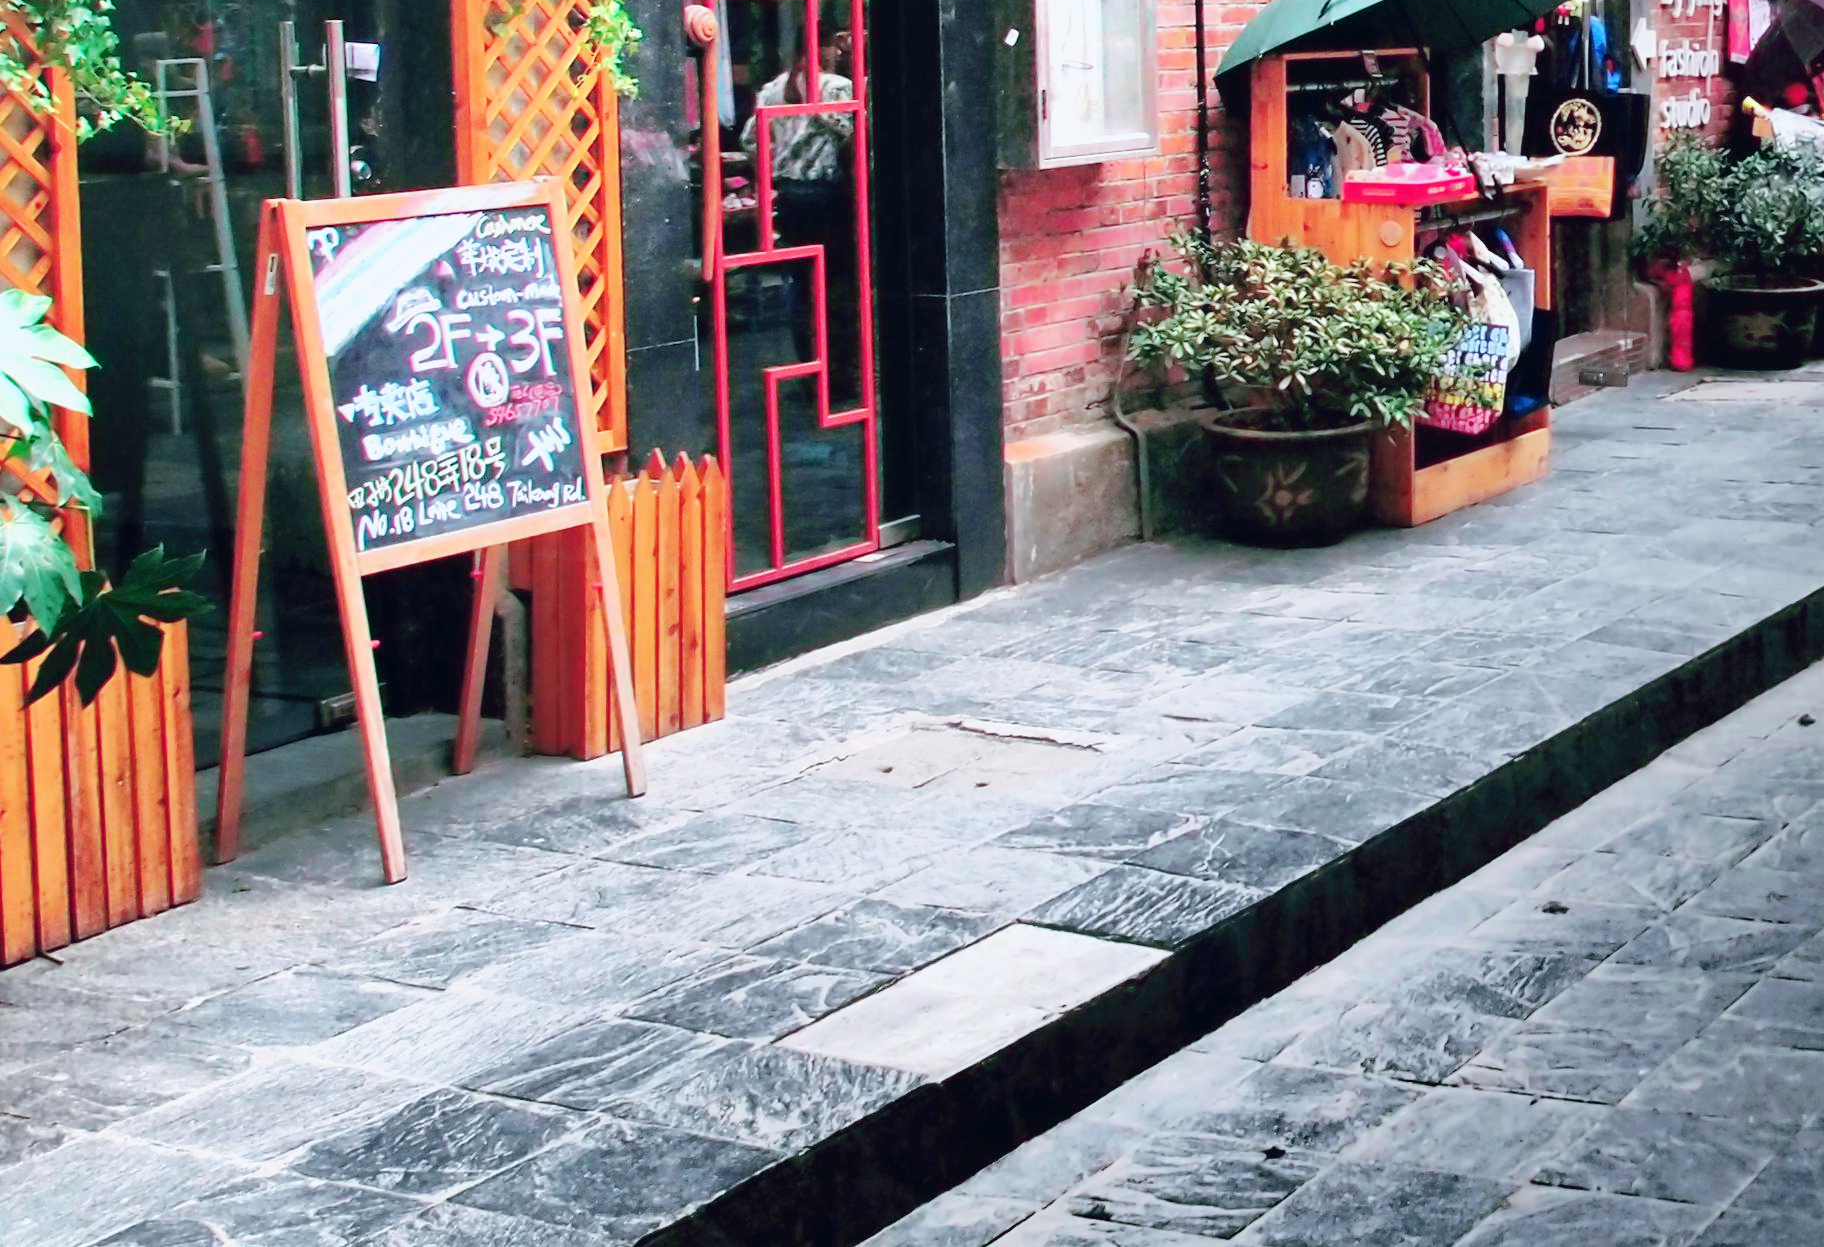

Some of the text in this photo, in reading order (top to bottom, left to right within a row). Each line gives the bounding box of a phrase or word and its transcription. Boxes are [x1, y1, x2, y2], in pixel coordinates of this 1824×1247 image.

[1658, 38, 1719, 79] fashion
[1659, 88, 1711, 129] studio
[405, 312, 472, 373] 2F
[506, 308, 564, 376] 3F
[418, 499, 463, 526] Lane
[463, 481, 505, 512] 248
